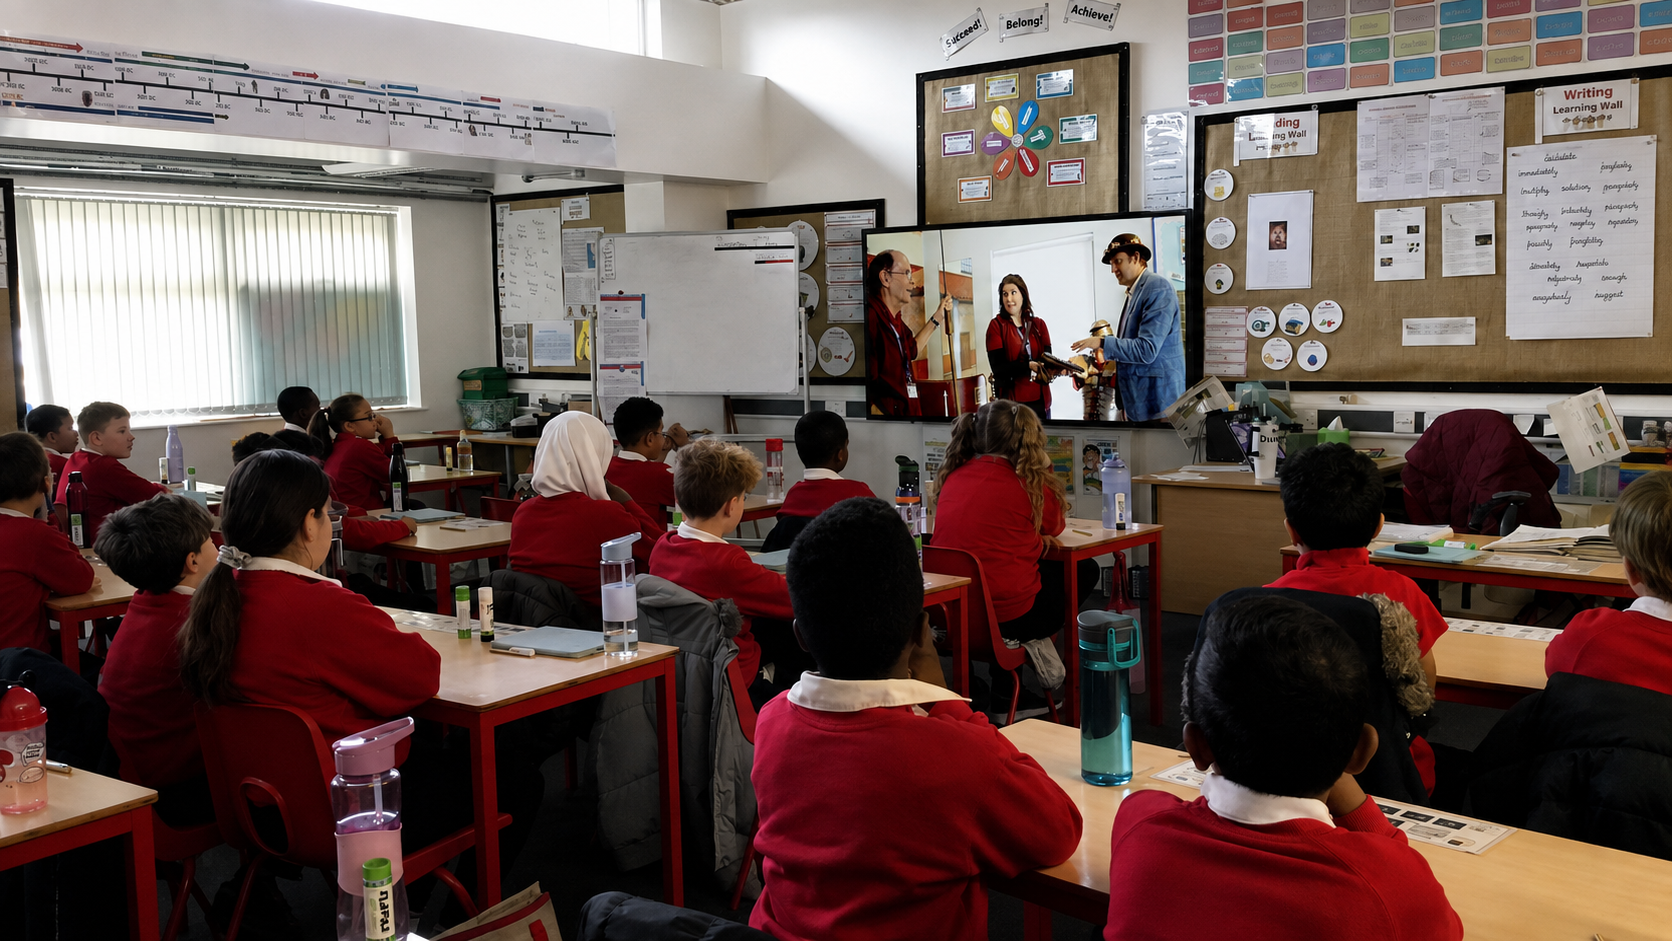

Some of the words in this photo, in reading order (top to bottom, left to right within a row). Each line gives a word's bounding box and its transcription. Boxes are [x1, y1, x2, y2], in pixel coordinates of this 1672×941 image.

[1071, 4, 1114, 23] Achieve!
[1006, 14, 1043, 30] Belong!
[945, 18, 982, 48] Succeed!
[1564, 87, 1613, 100] Writing
[1553, 103, 1597, 114] Learning
[1600, 100, 1623, 110] Wall
[1288, 129, 1307, 138] Wall
